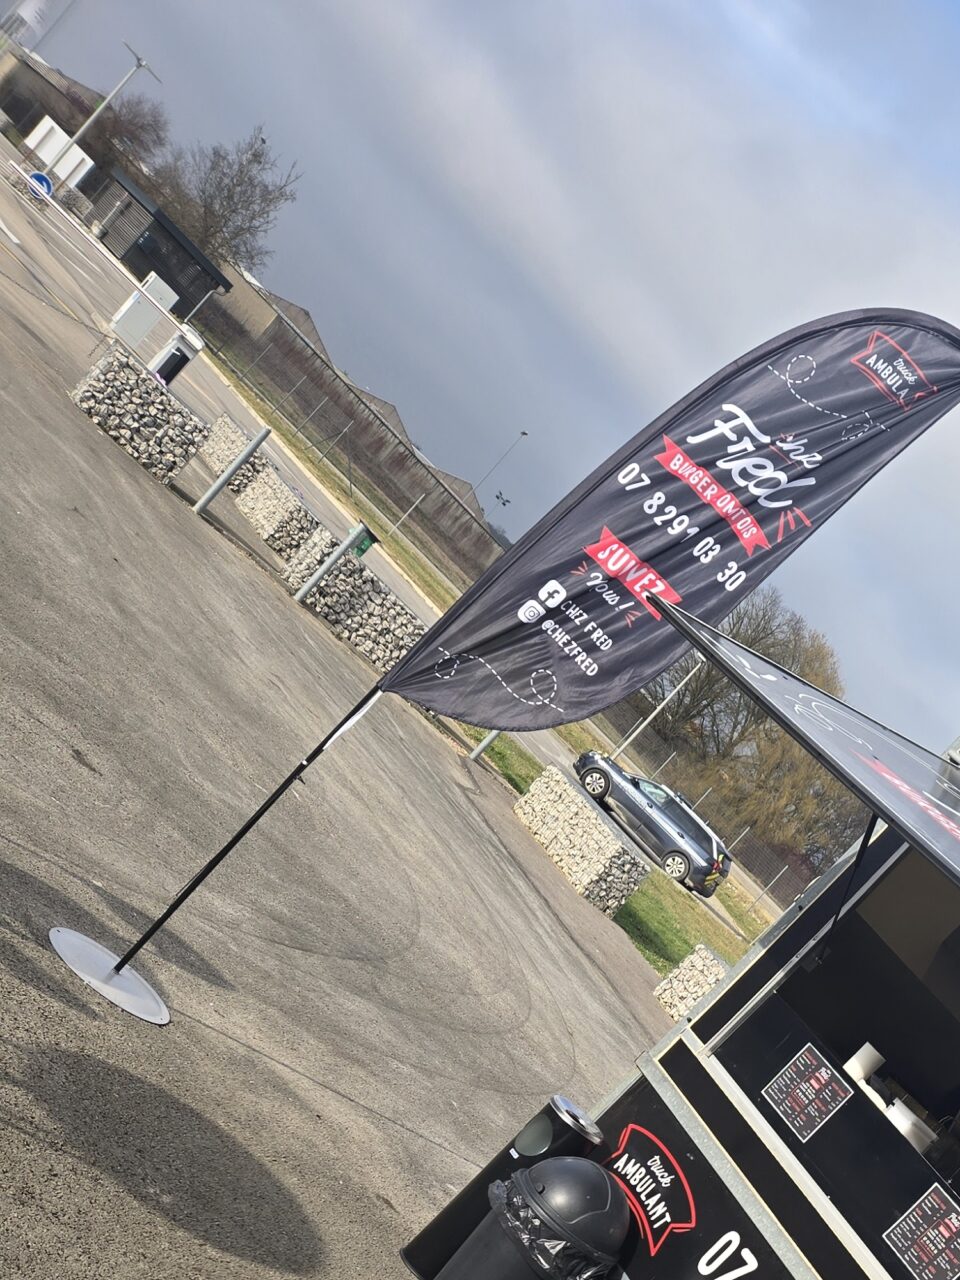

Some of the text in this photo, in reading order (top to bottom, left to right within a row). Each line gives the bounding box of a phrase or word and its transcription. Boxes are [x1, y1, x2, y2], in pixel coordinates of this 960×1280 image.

[893, 358, 918, 385] truck
[686, 403, 816, 508] Fred
[669, 454, 758, 538] BURGER OMTOIS
[617, 462, 651, 491] 07
[692, 537, 721, 564] 03
[716, 561, 747, 592] 30
[597, 543, 666, 601] SUIVEZ
[541, 619, 599, 676] @CHEZFRED
[560, 600, 613, 651] CHEZ FRED
[613, 1153, 671, 1228] AMBULANT
[646, 1155, 675, 1187] truck
